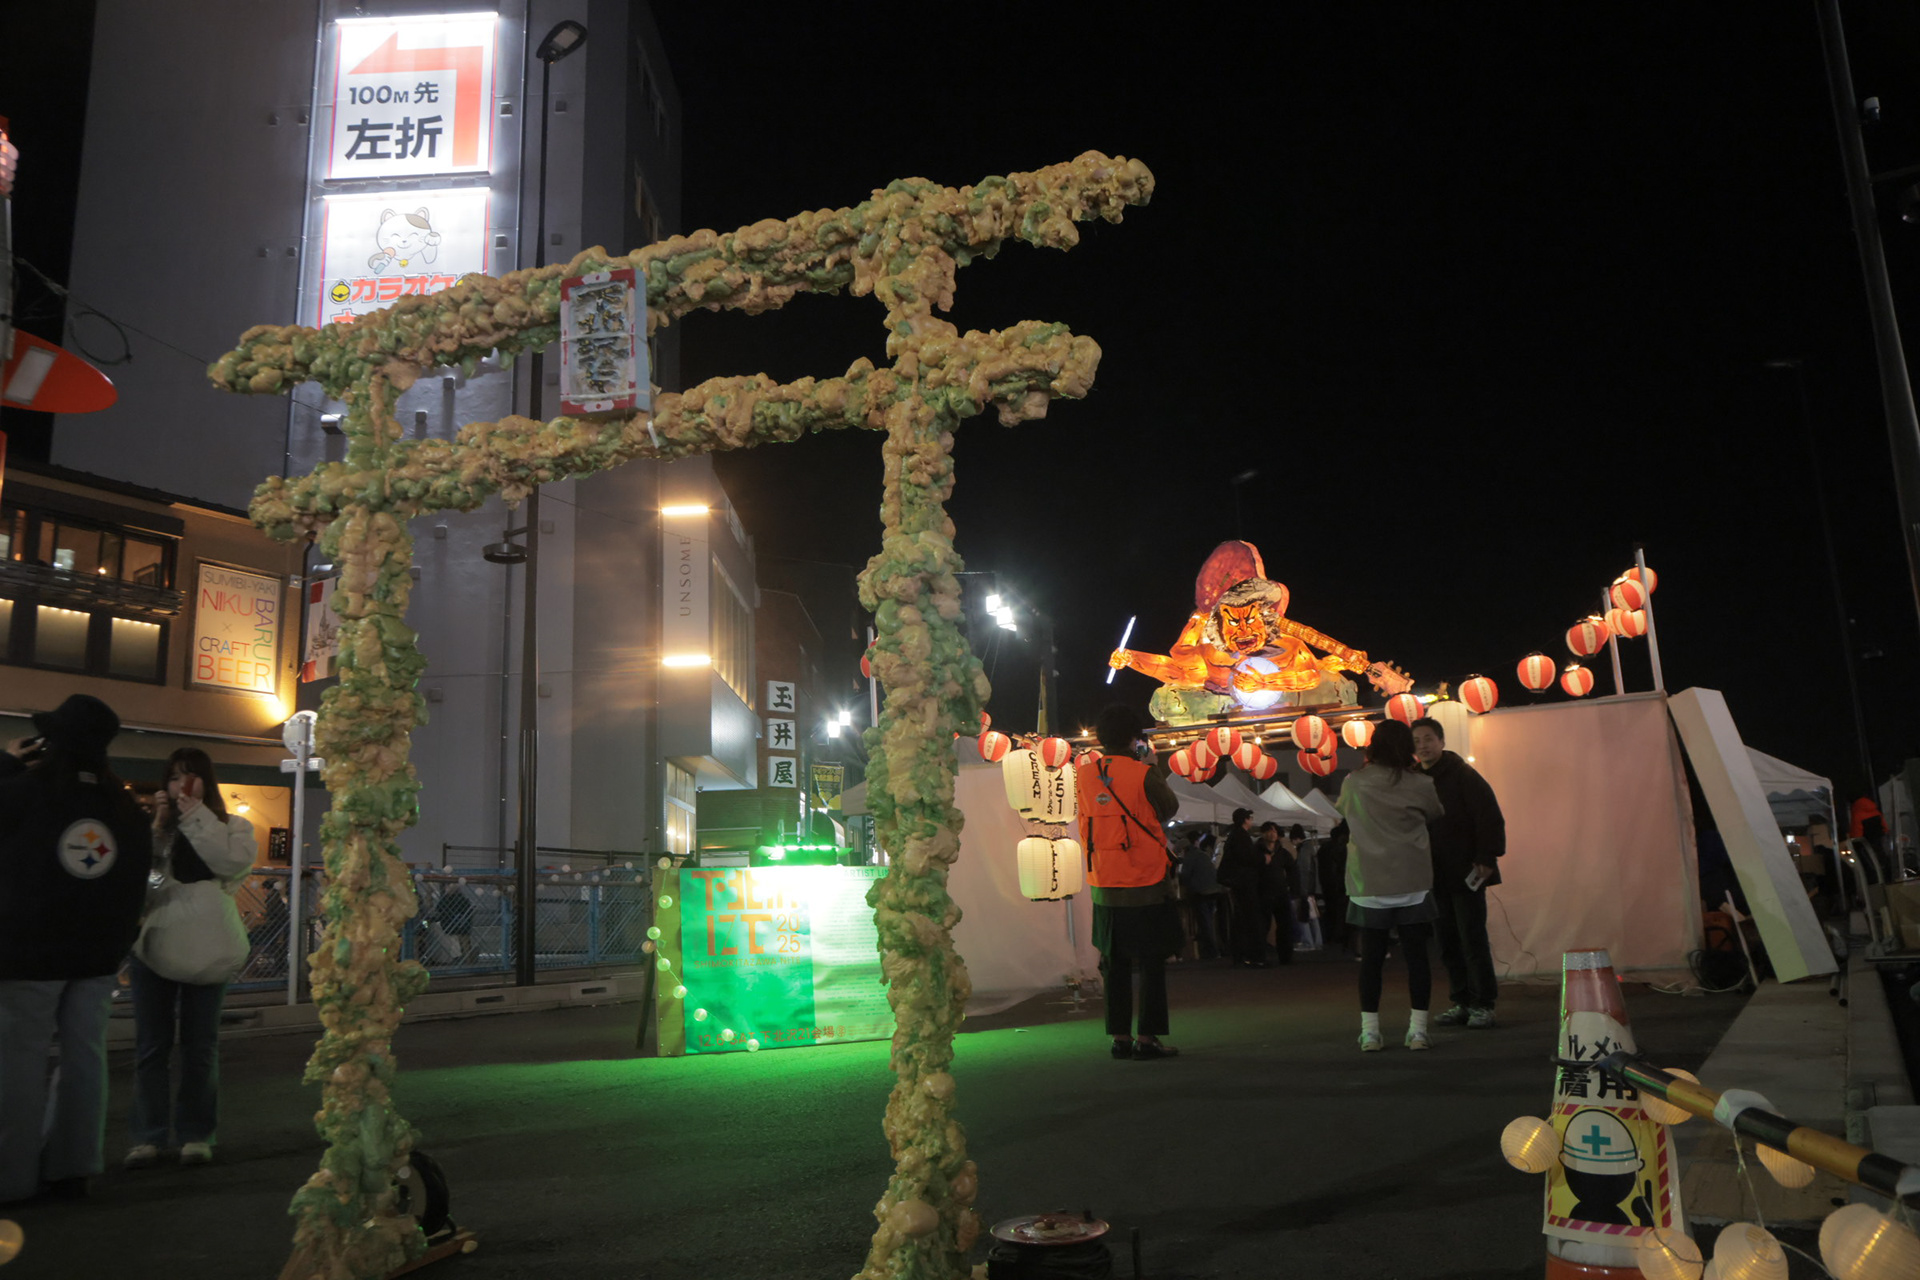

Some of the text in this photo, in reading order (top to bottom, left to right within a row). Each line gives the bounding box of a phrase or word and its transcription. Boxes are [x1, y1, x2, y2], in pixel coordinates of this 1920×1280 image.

[344, 115, 443, 160] 左折
[203, 571, 276, 595] SUMIBI-YAKI
[680, 536, 691, 617] UNSOME
[202, 588, 254, 616] NIKU
[253, 598, 275, 661] BARU
[199, 636, 251, 657] CRAFT
[197, 654, 270, 688] BEER
[772, 685, 794, 785] 玉井屋
[777, 913, 801, 932] 20
[777, 934, 801, 953] 25
[694, 957, 777, 969] SHIMOKITAZAWA
